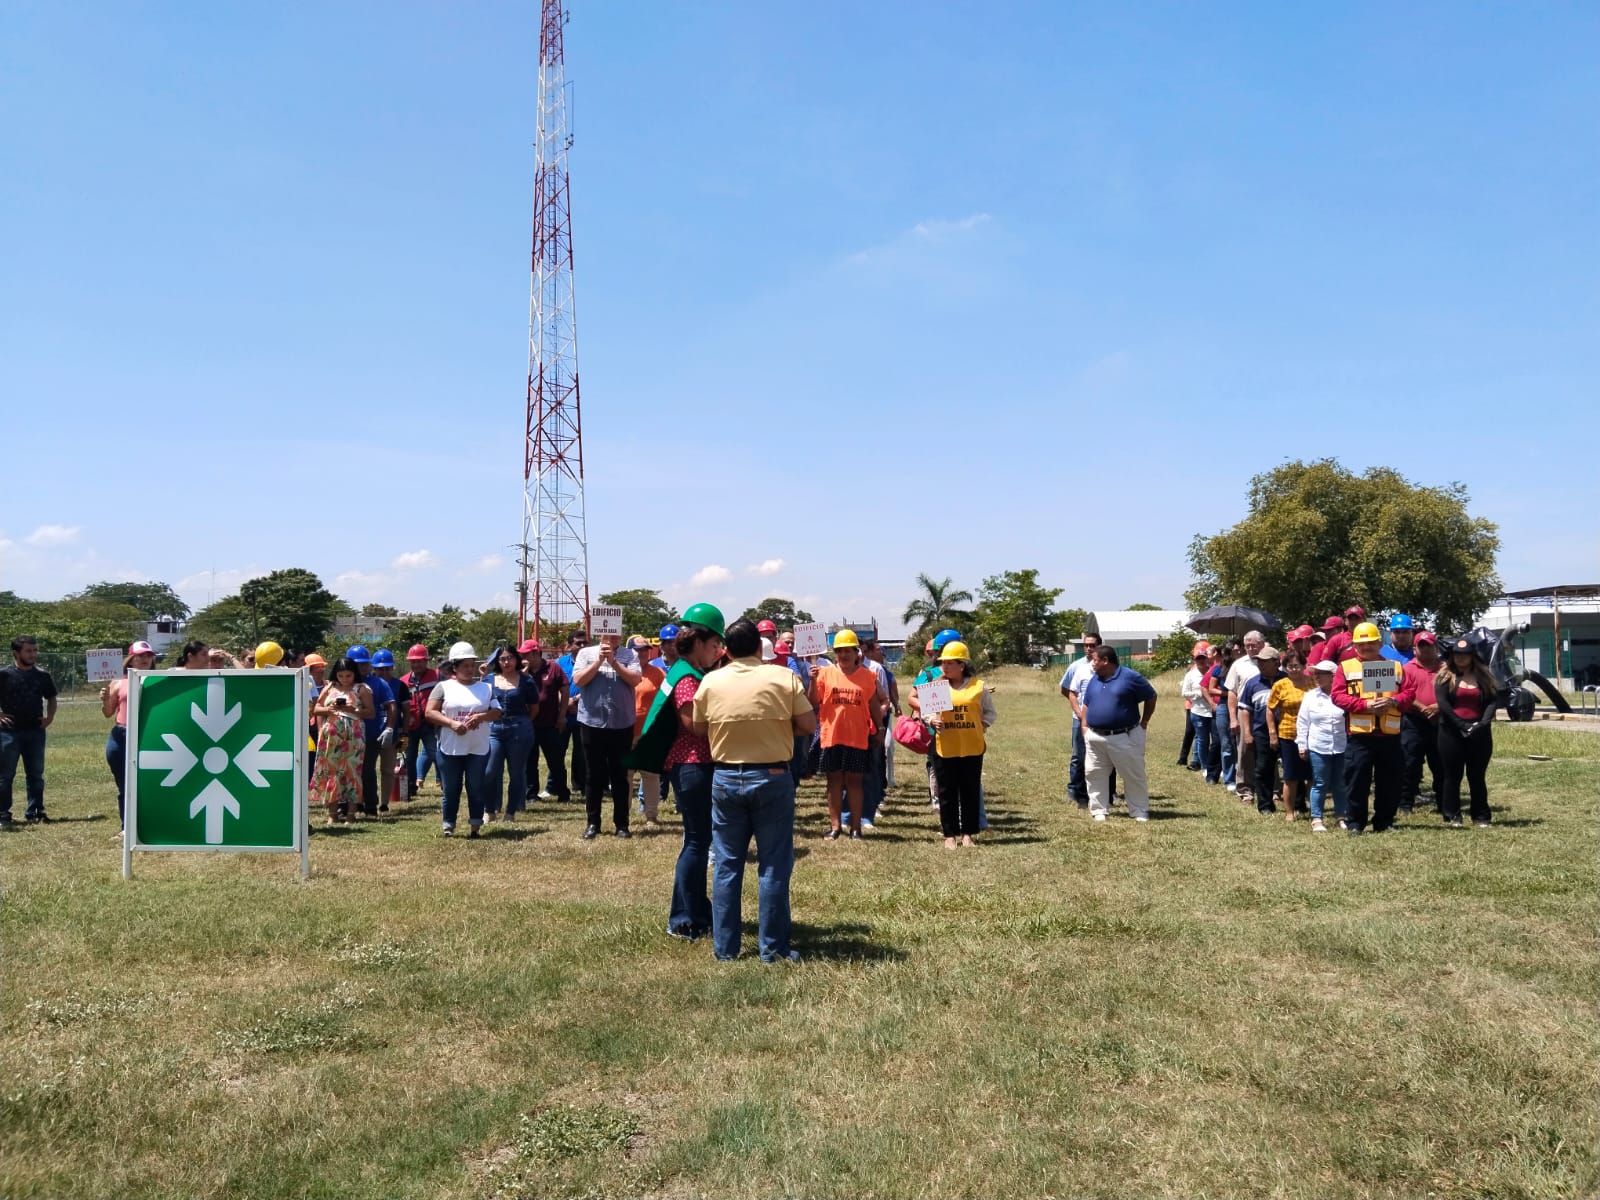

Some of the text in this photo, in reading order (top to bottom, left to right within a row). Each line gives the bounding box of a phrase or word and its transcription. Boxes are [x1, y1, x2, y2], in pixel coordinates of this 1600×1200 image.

[592, 607, 621, 617] EDIFICIO
[603, 619, 608, 628] C
[794, 623, 824, 632] EDIFICIO
[1364, 668, 1394, 678] EDIFICIO
[917, 680, 949, 690] EDIFICIO
